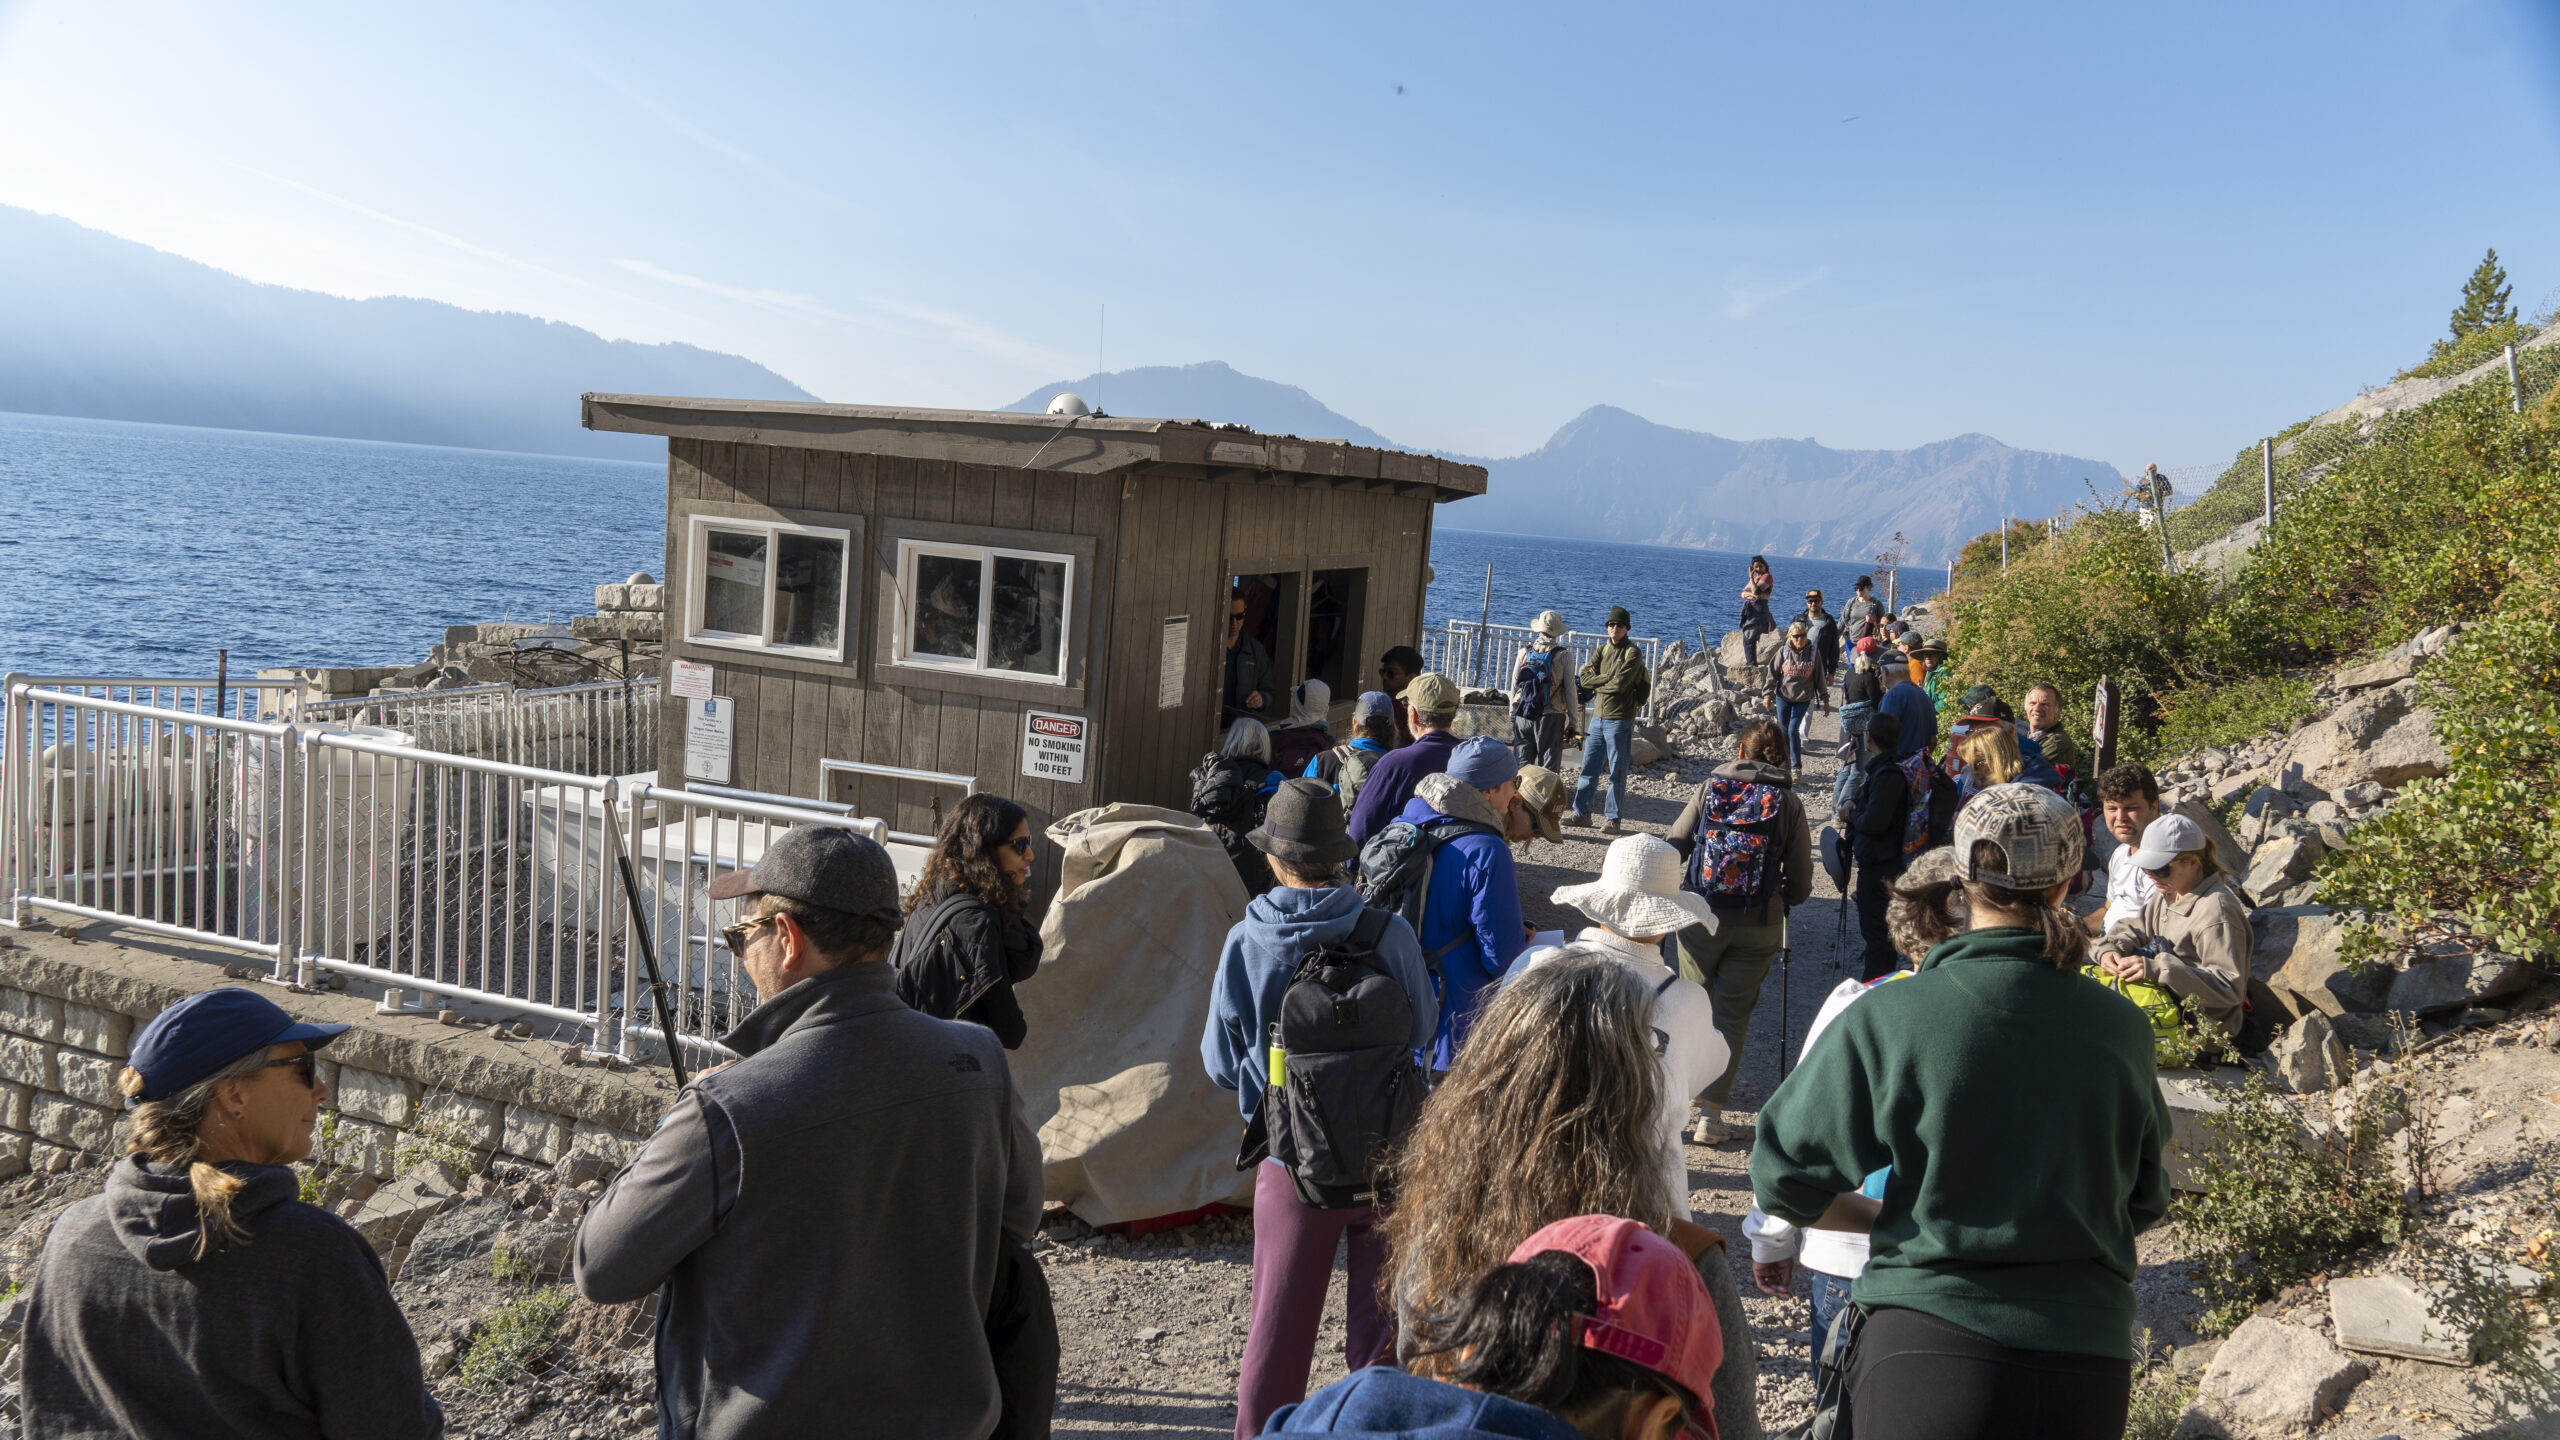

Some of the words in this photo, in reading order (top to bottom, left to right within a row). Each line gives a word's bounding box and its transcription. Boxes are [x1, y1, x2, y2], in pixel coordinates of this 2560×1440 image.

[1035, 720, 1077, 734] DANGER
[1028, 737, 1040, 747] NO
[1042, 739, 1081, 752] SMOKING
[1038, 750, 1069, 763] WITHIN
[1033, 762, 1049, 773] 100
[1051, 765, 1072, 776] FEET
